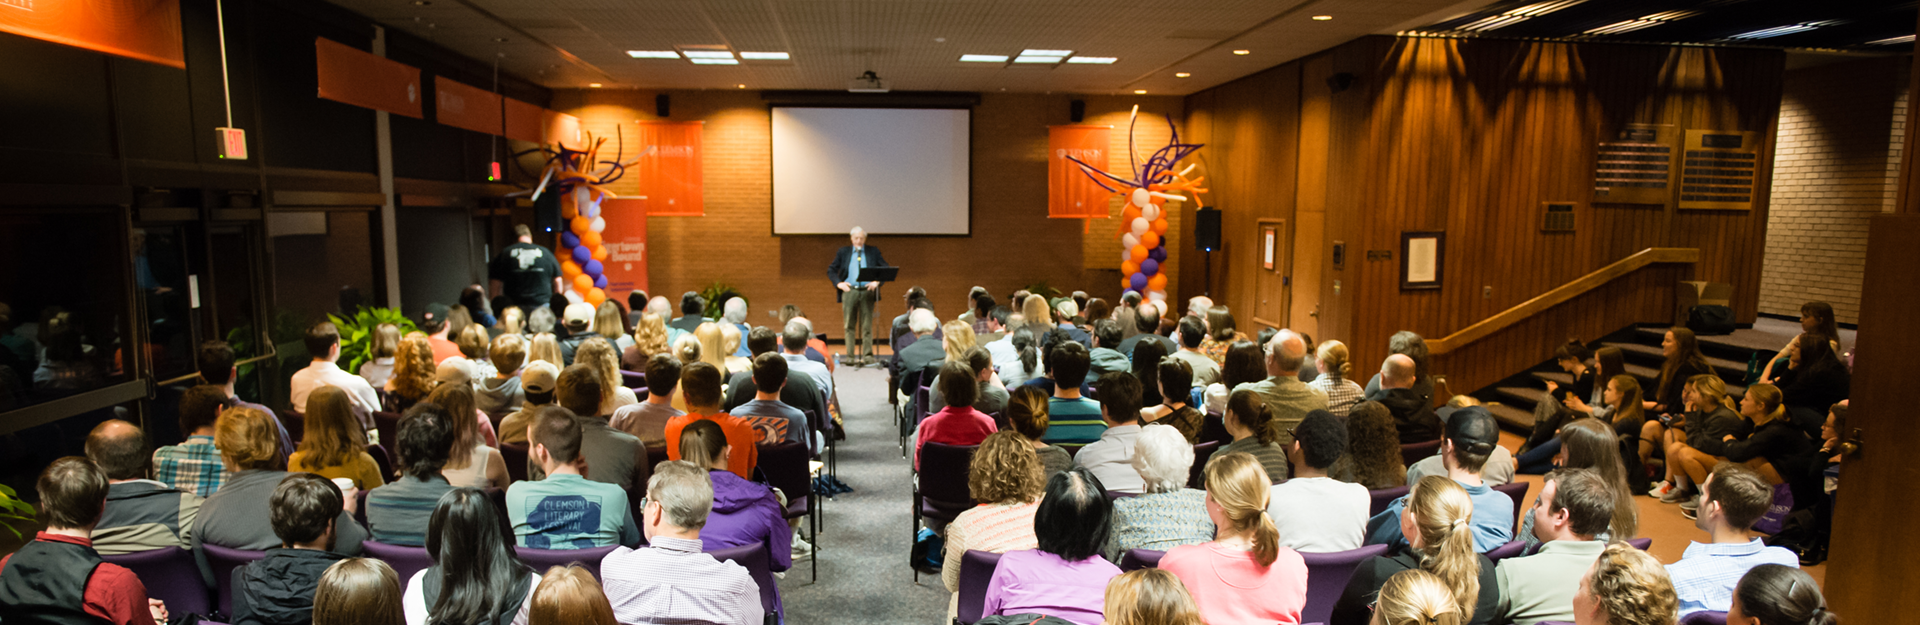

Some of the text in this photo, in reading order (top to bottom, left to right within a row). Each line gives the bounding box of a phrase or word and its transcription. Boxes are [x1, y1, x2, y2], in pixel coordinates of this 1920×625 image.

[228, 131, 244, 156] EXIT
[544, 500, 585, 510] CLEMSON
[544, 511, 585, 521] LITERARY
